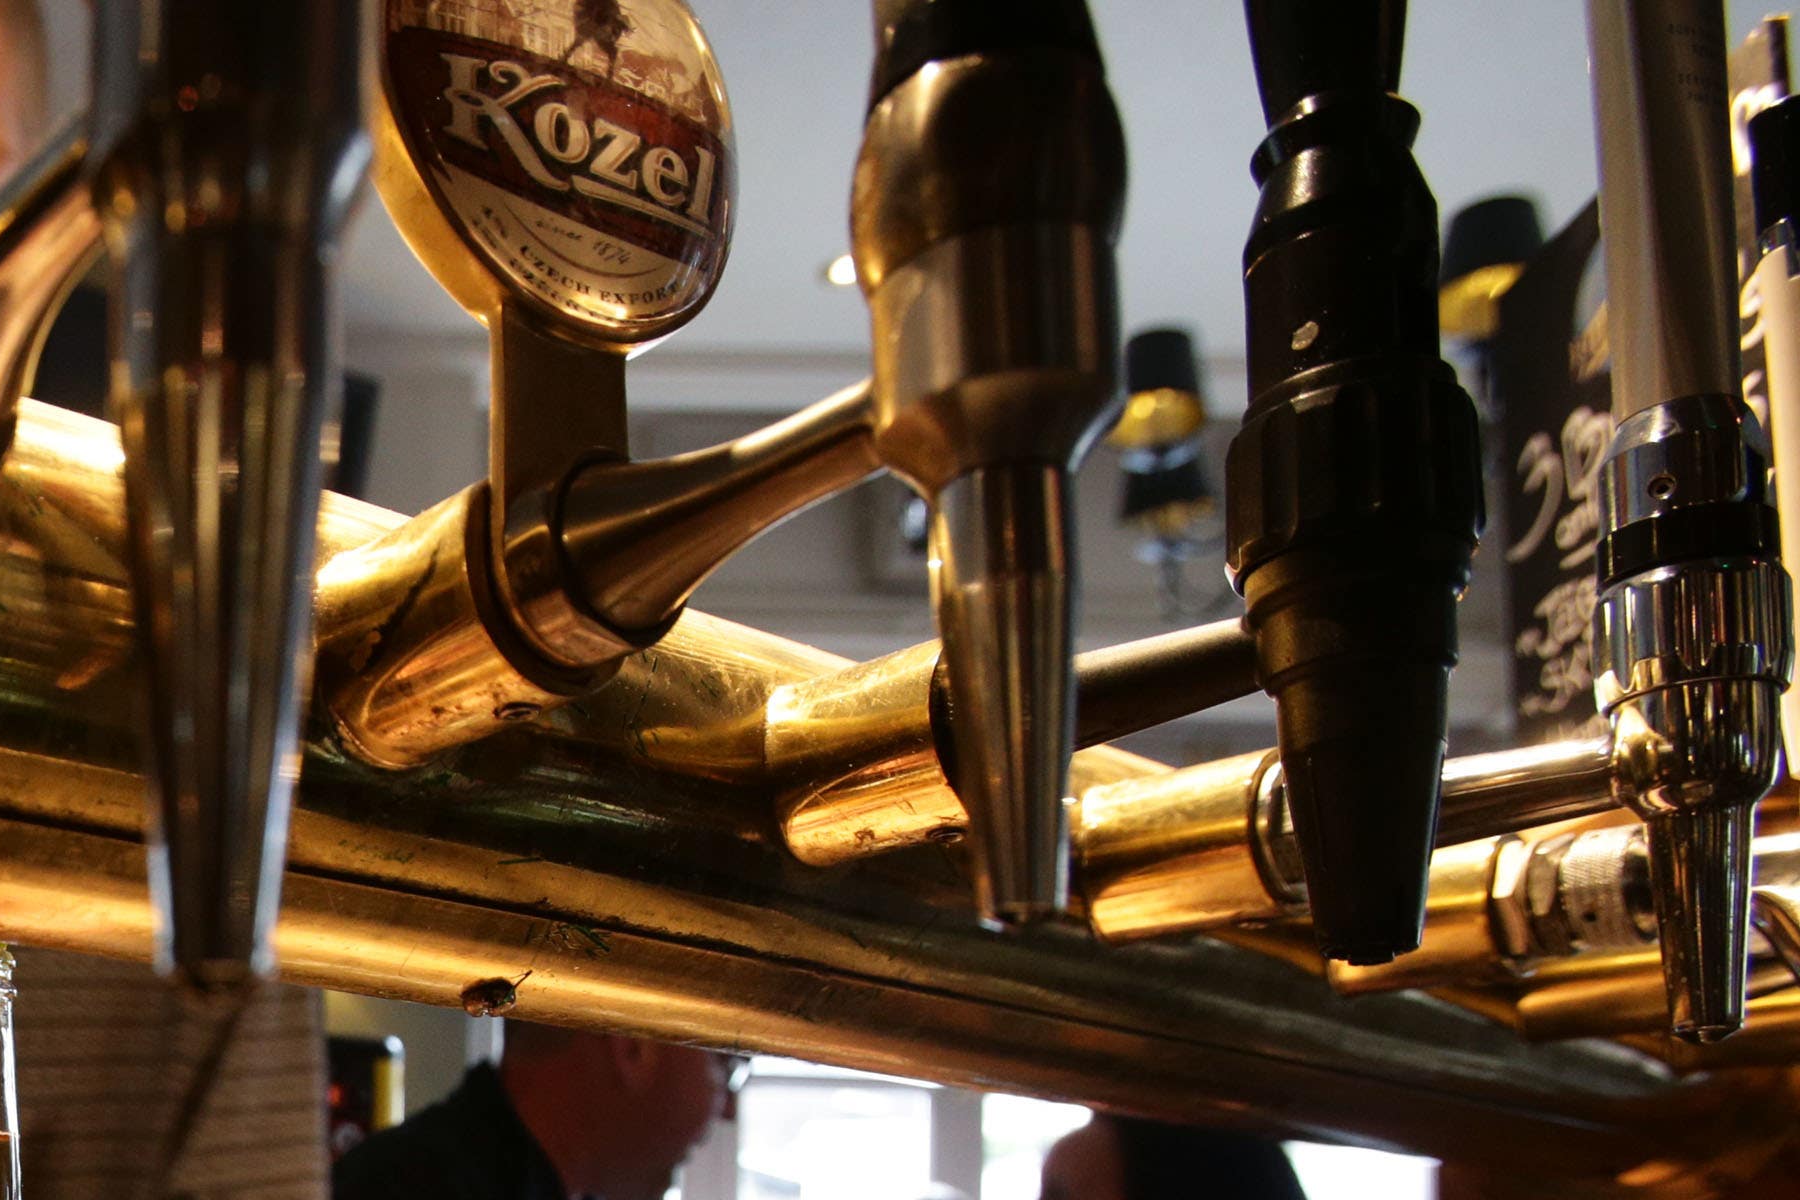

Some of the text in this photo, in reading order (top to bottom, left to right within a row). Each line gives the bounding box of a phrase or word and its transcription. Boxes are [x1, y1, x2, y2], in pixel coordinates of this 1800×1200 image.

[439, 54, 716, 226] Kozel
[519, 246, 591, 296] CZECH
[600, 281, 681, 306] EXPORT
